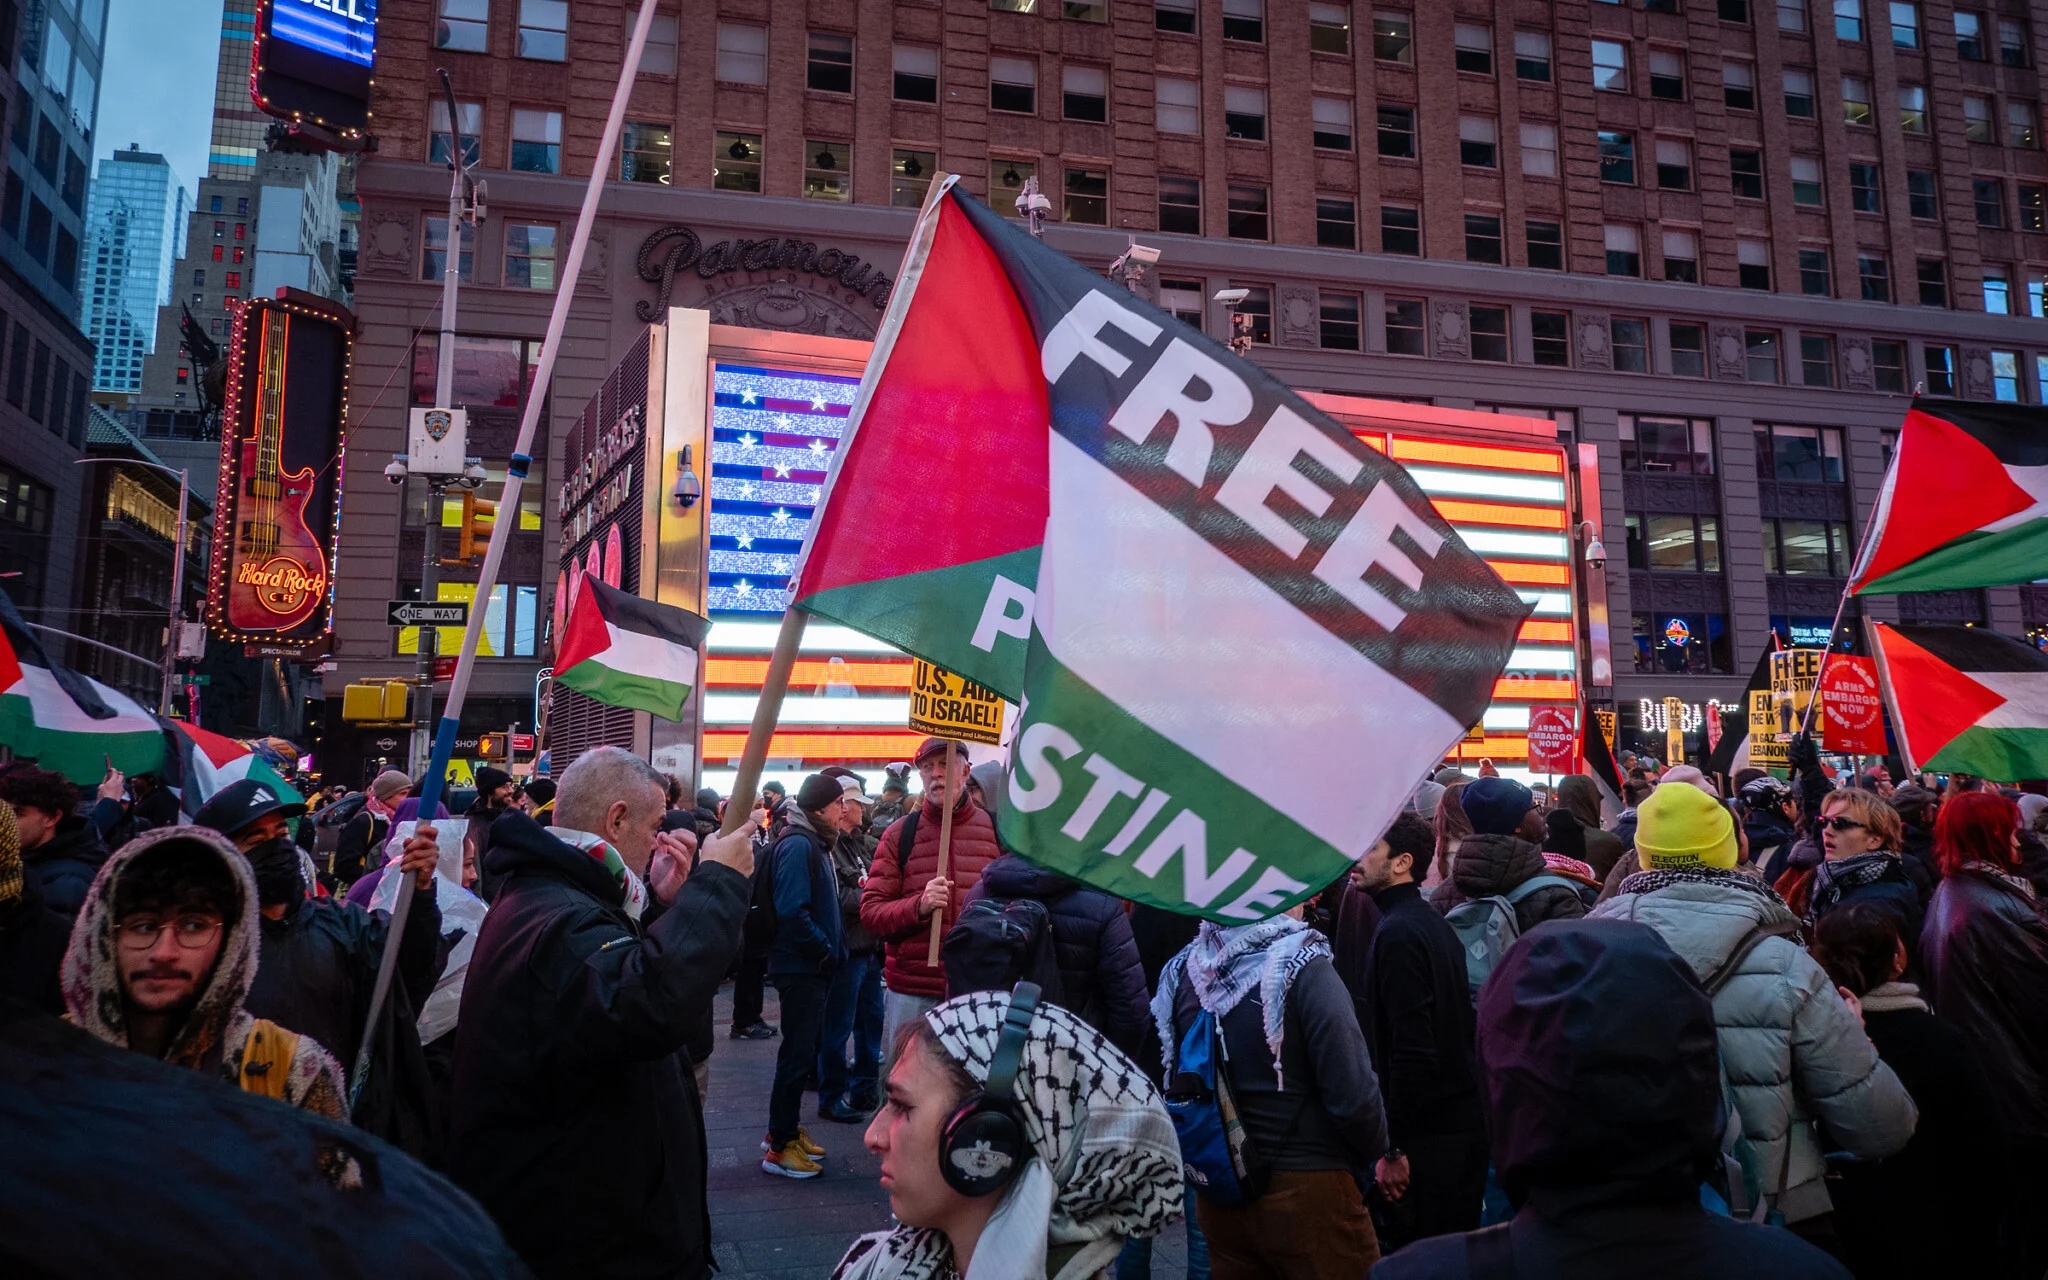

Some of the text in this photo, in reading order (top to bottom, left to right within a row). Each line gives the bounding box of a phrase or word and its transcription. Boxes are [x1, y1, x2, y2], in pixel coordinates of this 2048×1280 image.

[301, 0, 364, 22] ELL
[635, 226, 894, 323] Paramoun
[1041, 289, 1447, 632] FREE
[238, 562, 324, 597] Hard Rock
[269, 592, 295, 604] CFE
[400, 609, 458, 619] ONE WAY
[261, 647, 301, 656] SPECTACOLOR
[1774, 652, 1819, 680] FREE
[917, 661, 954, 696] U.S.
[1834, 681, 1865, 693] ARMS
[1756, 694, 1772, 711] EN
[1823, 691, 1879, 706] EMBARGO
[913, 692, 998, 728] TO ISRAEL!
[1639, 698, 1702, 733] BUBA
[1839, 703, 1865, 715] NOW
[1751, 713, 1763, 725] THE
[934, 728, 961, 737] Socialism
[974, 733, 998, 742] Liberation
[1537, 725, 1564, 733] ARMS
[1528, 732, 1573, 741] EMBARGO
[1760, 733, 1776, 743] GAZ
[455, 740, 478, 748] SHOP
[1750, 744, 1789, 757] LEBANON
[1651, 854, 1699, 864] ELECTION
